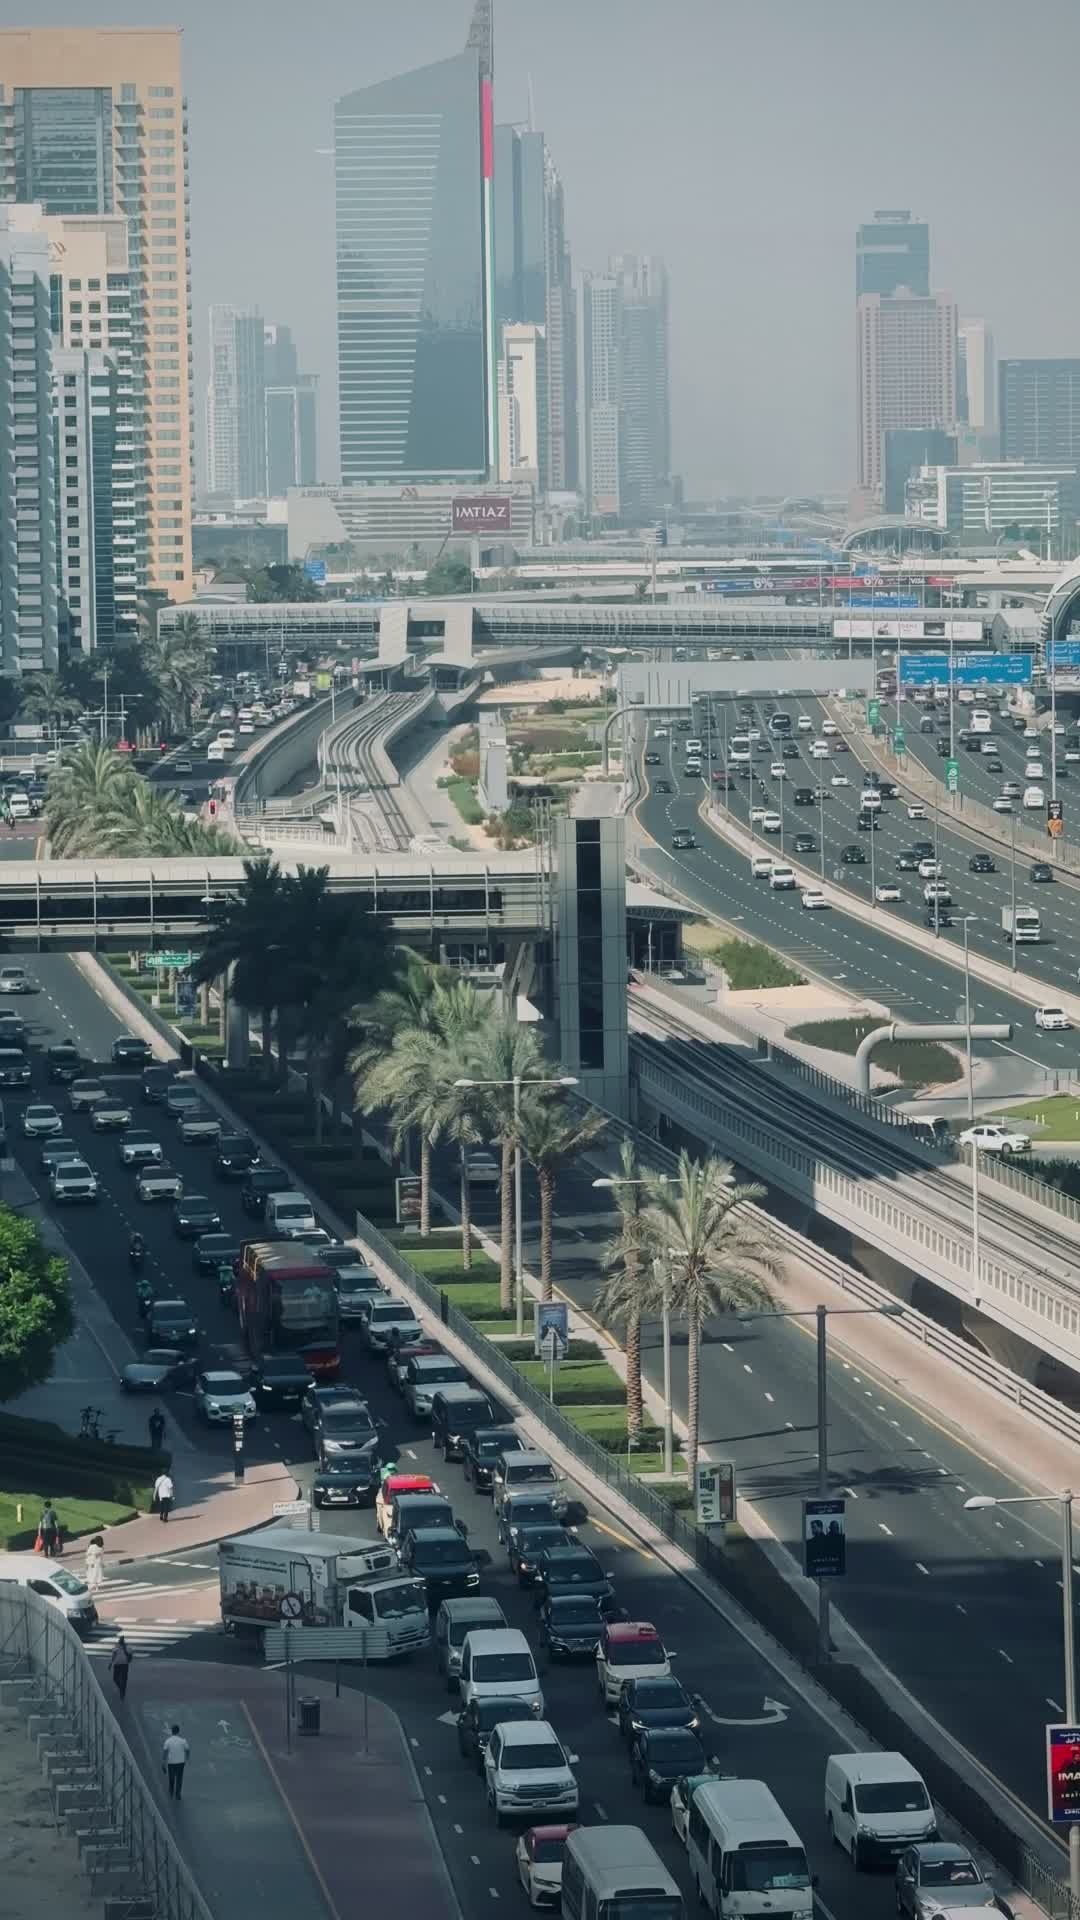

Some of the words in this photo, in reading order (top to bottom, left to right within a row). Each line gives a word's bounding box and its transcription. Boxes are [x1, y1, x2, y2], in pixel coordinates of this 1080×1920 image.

[456, 506, 506, 518] IMTIAZ
[753, 577, 774, 589] 6%
[863, 574, 883, 585] 6%
